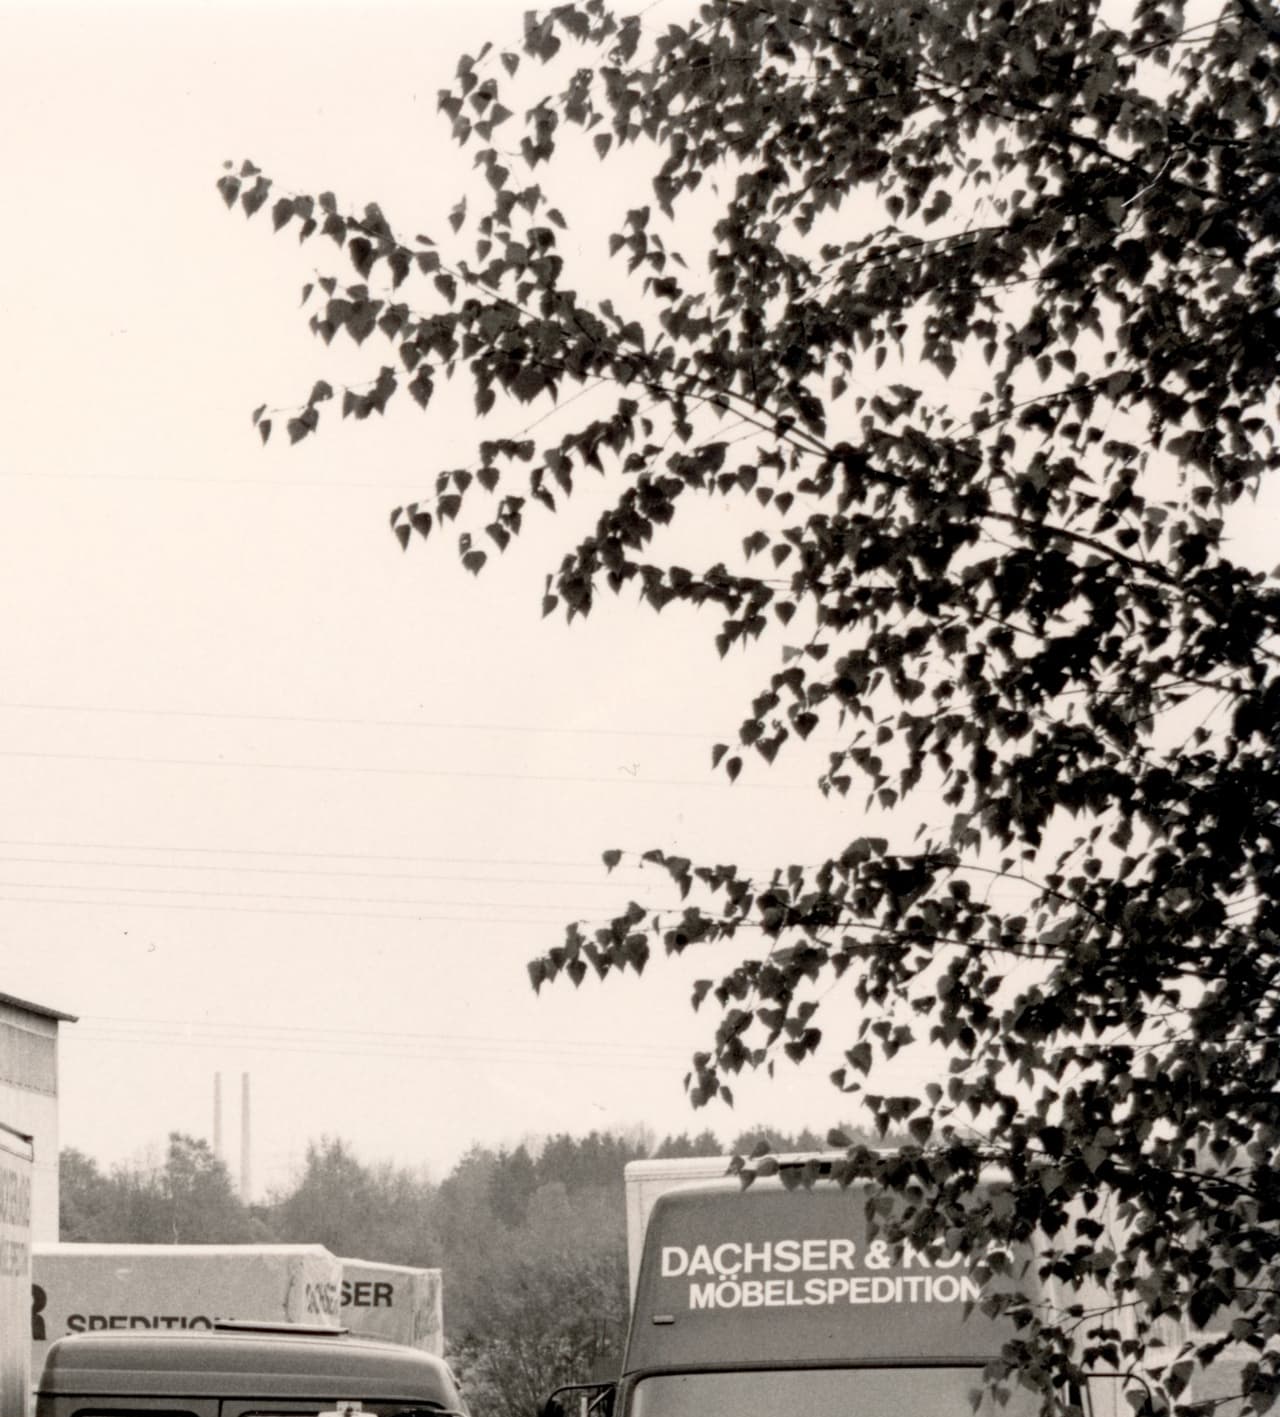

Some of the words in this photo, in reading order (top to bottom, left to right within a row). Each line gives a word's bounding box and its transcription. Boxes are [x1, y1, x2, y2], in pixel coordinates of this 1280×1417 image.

[661, 1238, 856, 1278] DACHSER
[864, 1240, 891, 1270] &
[688, 1273, 984, 1310] MÖBELSPEDITION
